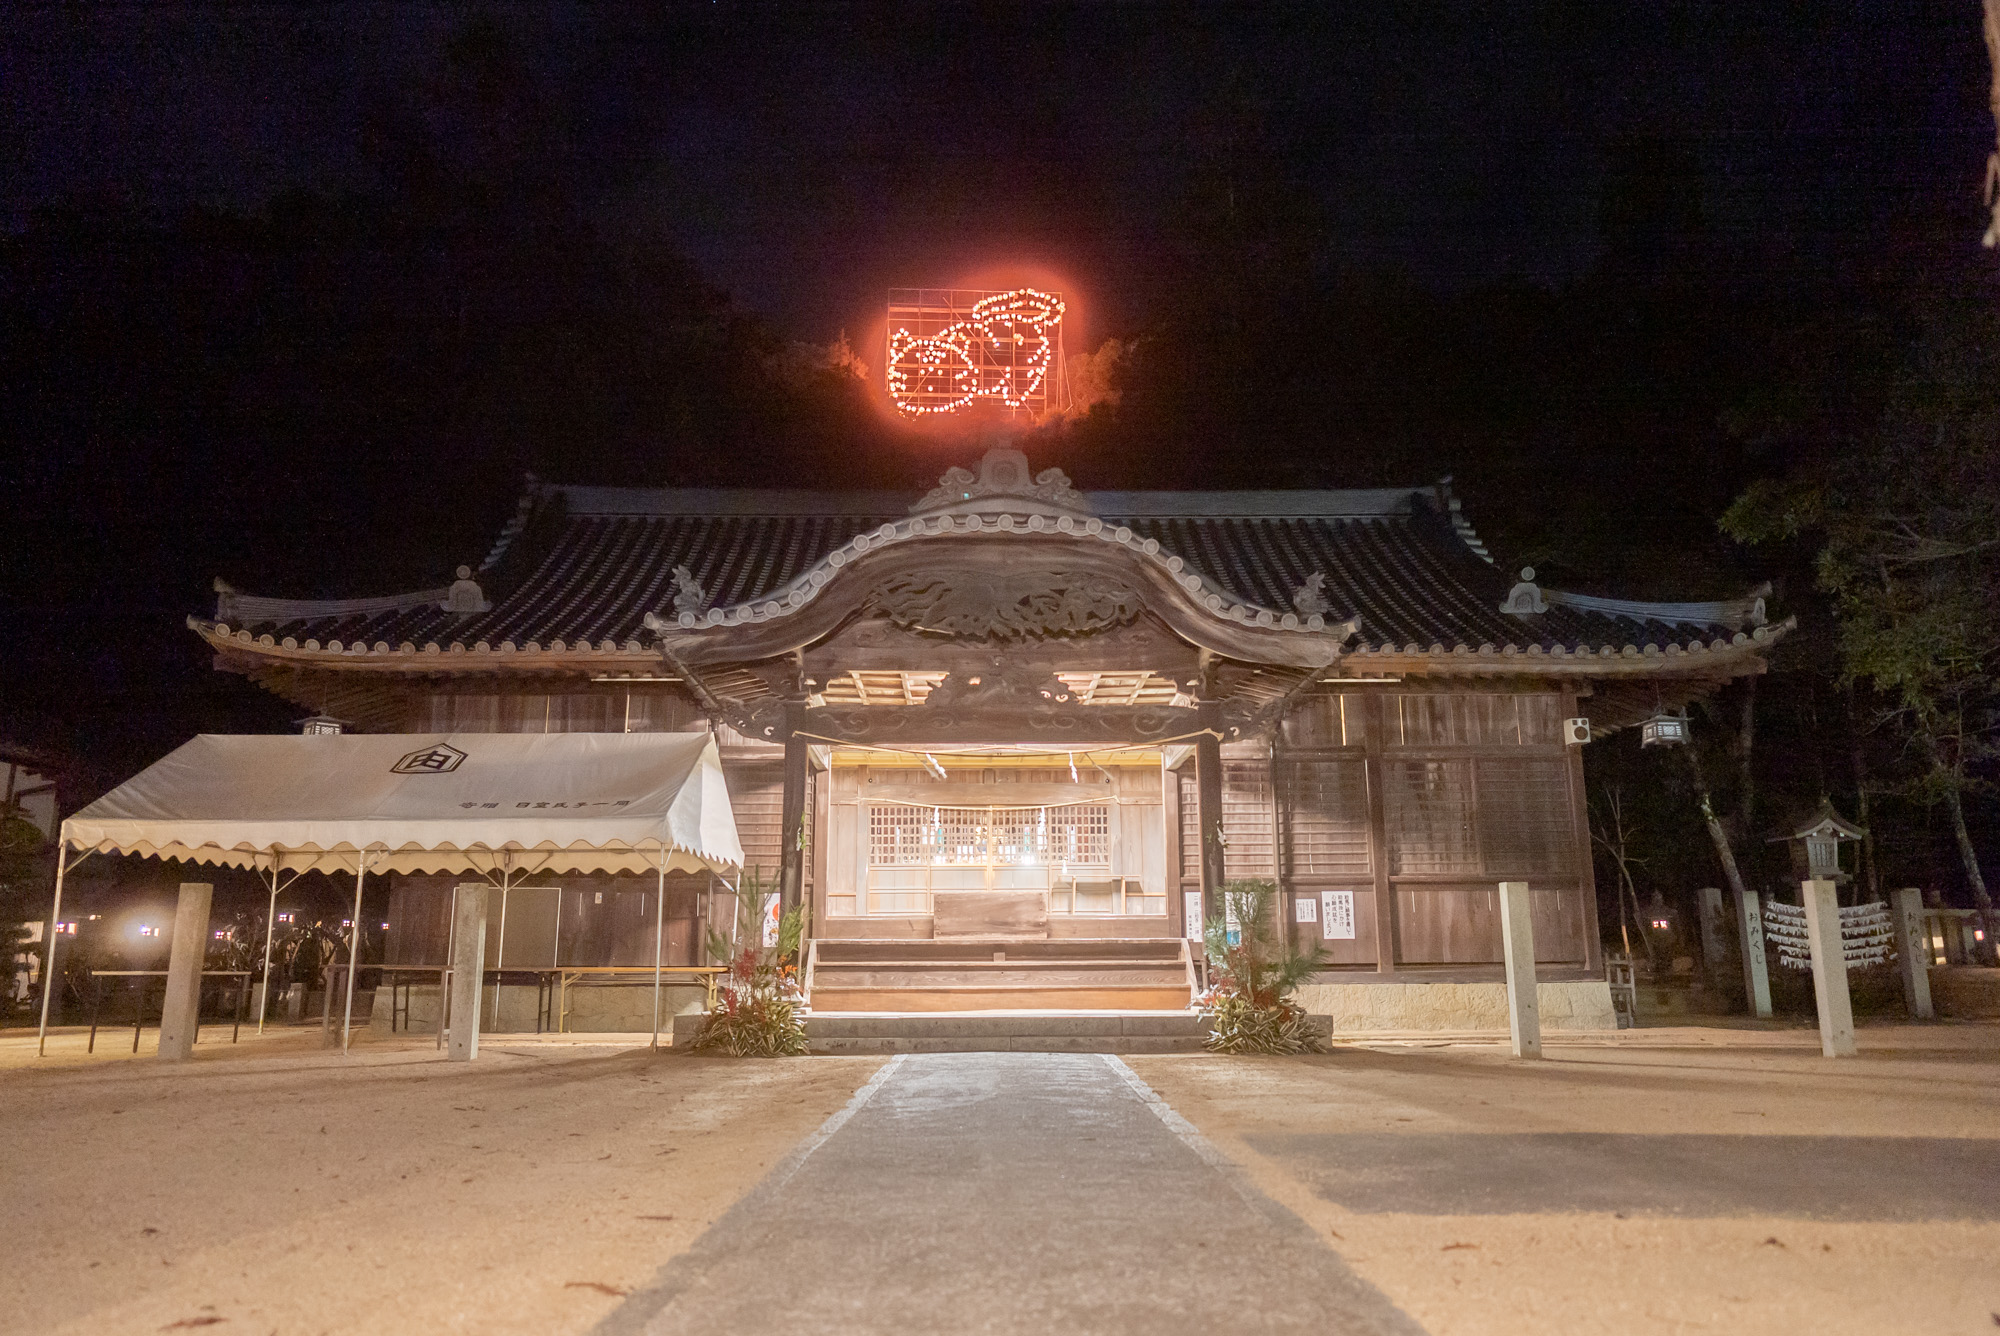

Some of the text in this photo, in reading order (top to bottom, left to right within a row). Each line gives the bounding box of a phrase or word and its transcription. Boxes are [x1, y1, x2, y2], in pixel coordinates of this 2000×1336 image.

[1748, 911, 1764, 966] おみくじ
[1907, 911, 1924, 964] おみくじ
